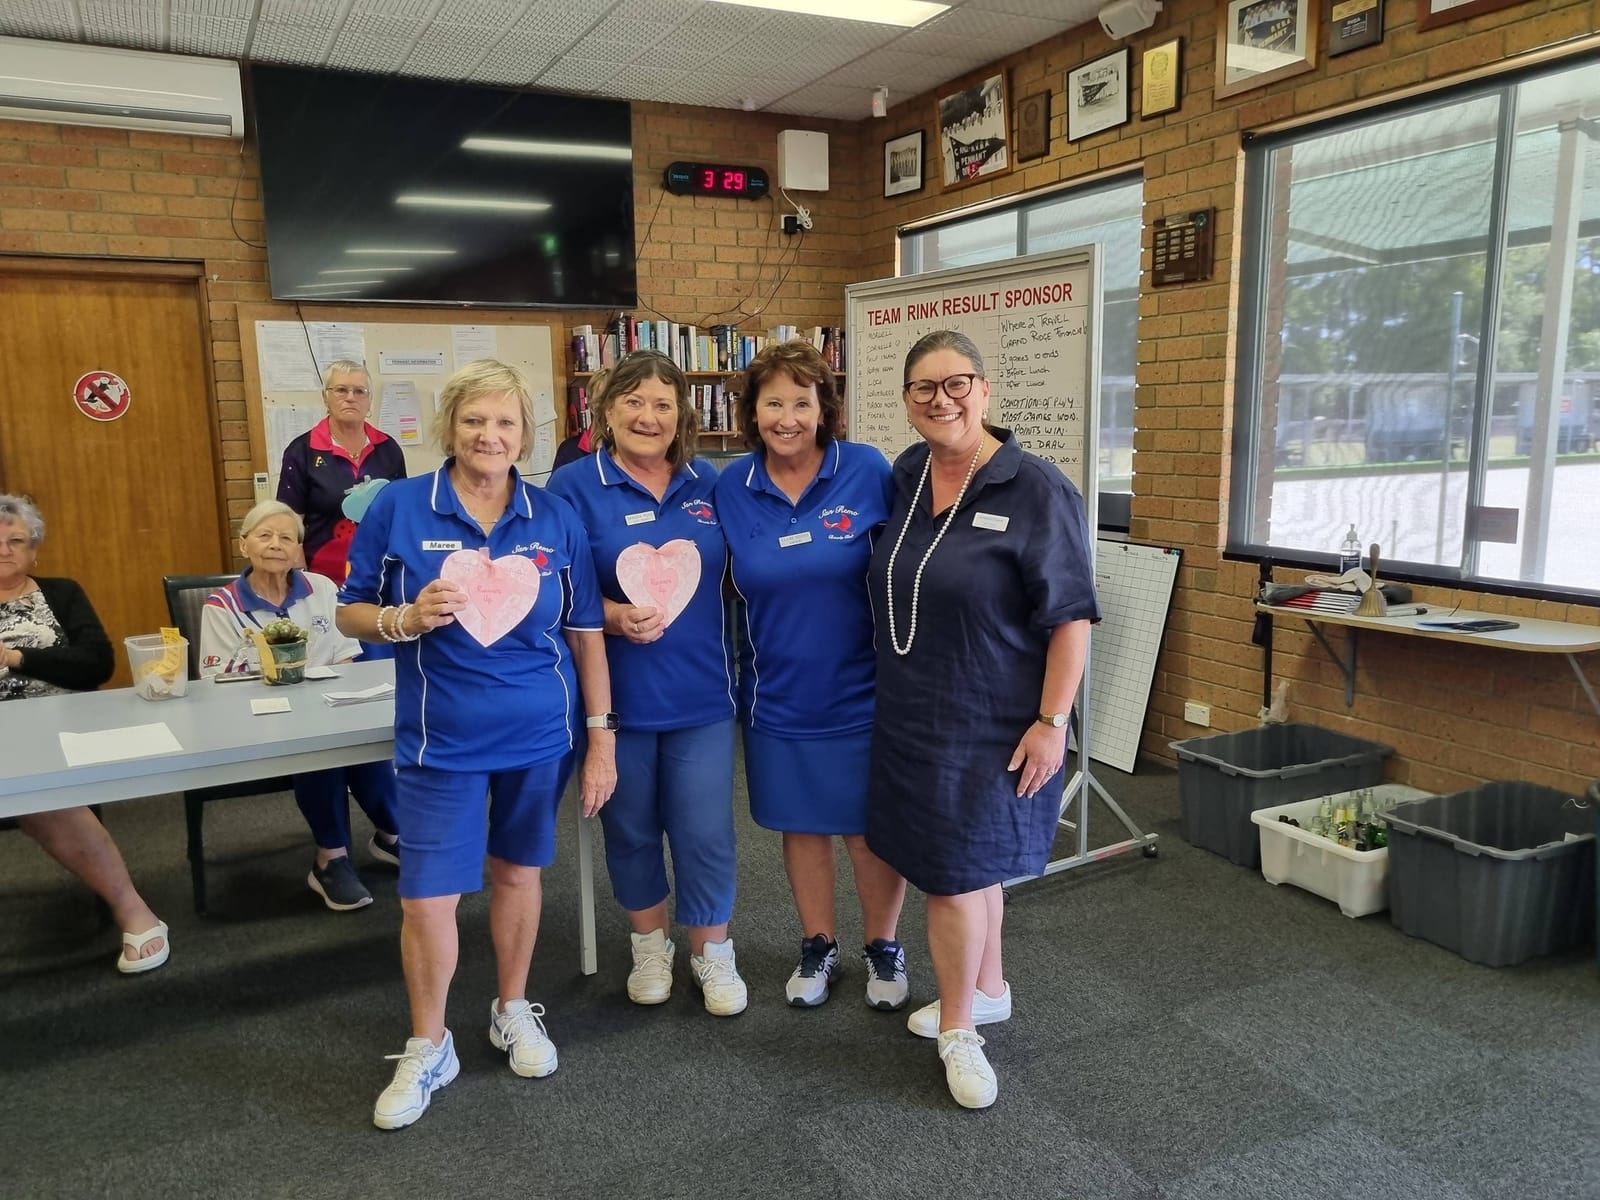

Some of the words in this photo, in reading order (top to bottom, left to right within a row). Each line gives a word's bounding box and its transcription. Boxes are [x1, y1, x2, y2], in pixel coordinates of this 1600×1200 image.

[723, 172, 744, 190] 29
[867, 307, 901, 326] TEAM
[907, 301, 938, 321] RINK
[942, 292, 999, 316] RESULT
[1005, 282, 1072, 308] SPONSOR
[1037, 312, 1069, 328] TRAVEL
[1000, 353, 1007, 365] 3
[1001, 411, 1023, 423] MOST
[1023, 412, 1052, 422] GAMES
[1037, 440, 1066, 449] DRAW
[818, 509, 834, 519] San
[835, 505, 859, 516] Remo
[429, 542, 455, 550] Maree
[512, 544, 529, 554] San
[529, 541, 555, 554] Remo
